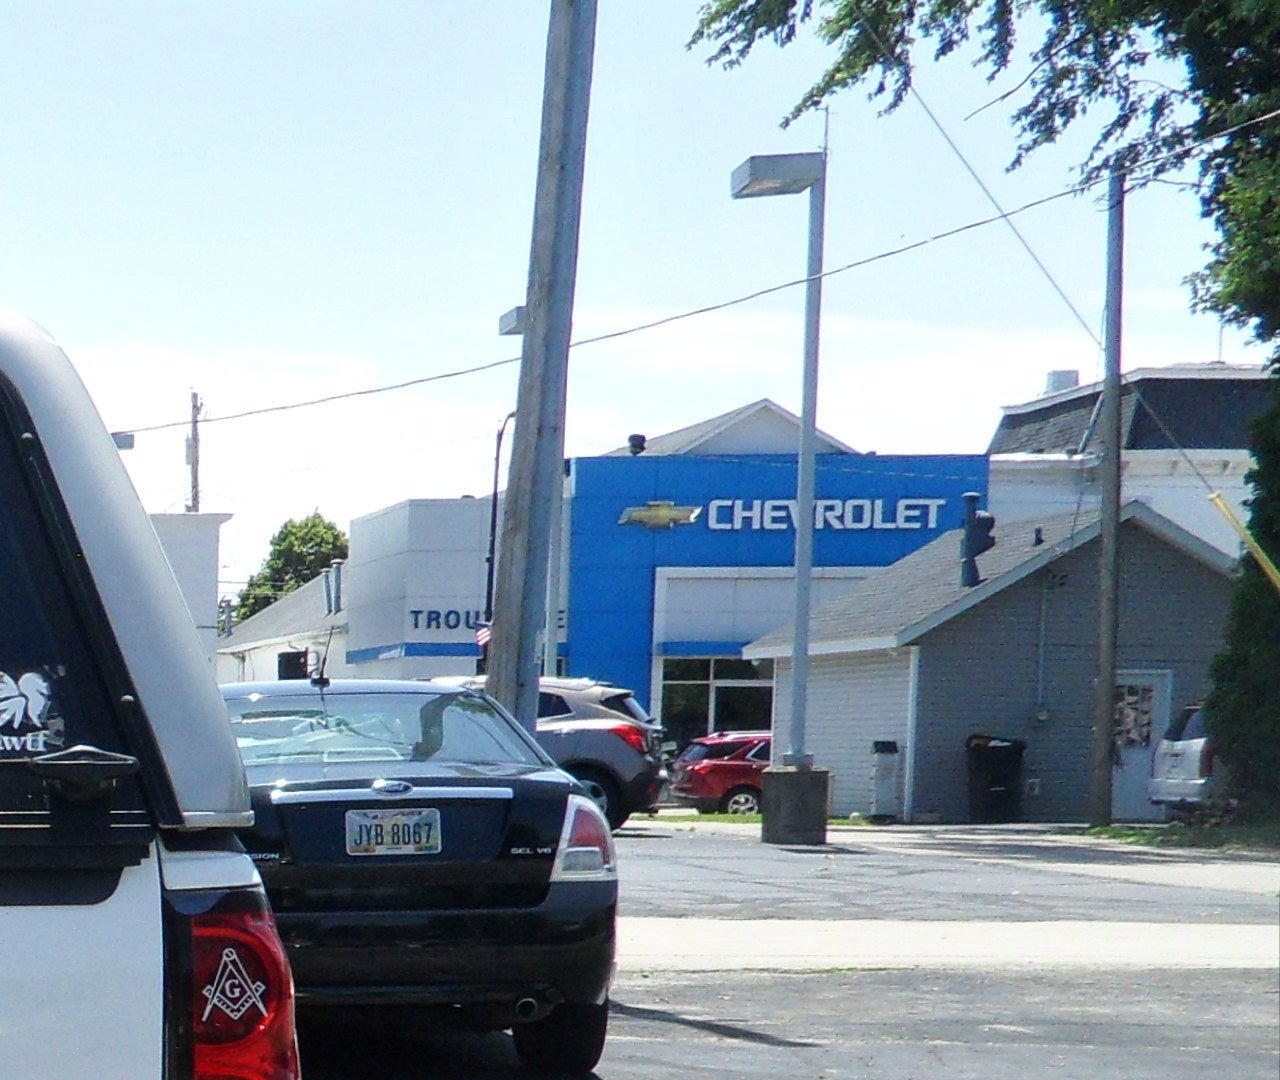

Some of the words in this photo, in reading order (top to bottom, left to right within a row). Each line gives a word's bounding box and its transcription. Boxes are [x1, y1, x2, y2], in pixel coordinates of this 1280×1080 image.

[708, 499, 946, 530] CHEVROLET
[354, 823, 384, 845] JYB
[391, 822, 432, 845] 8067
[224, 979, 241, 998] G
